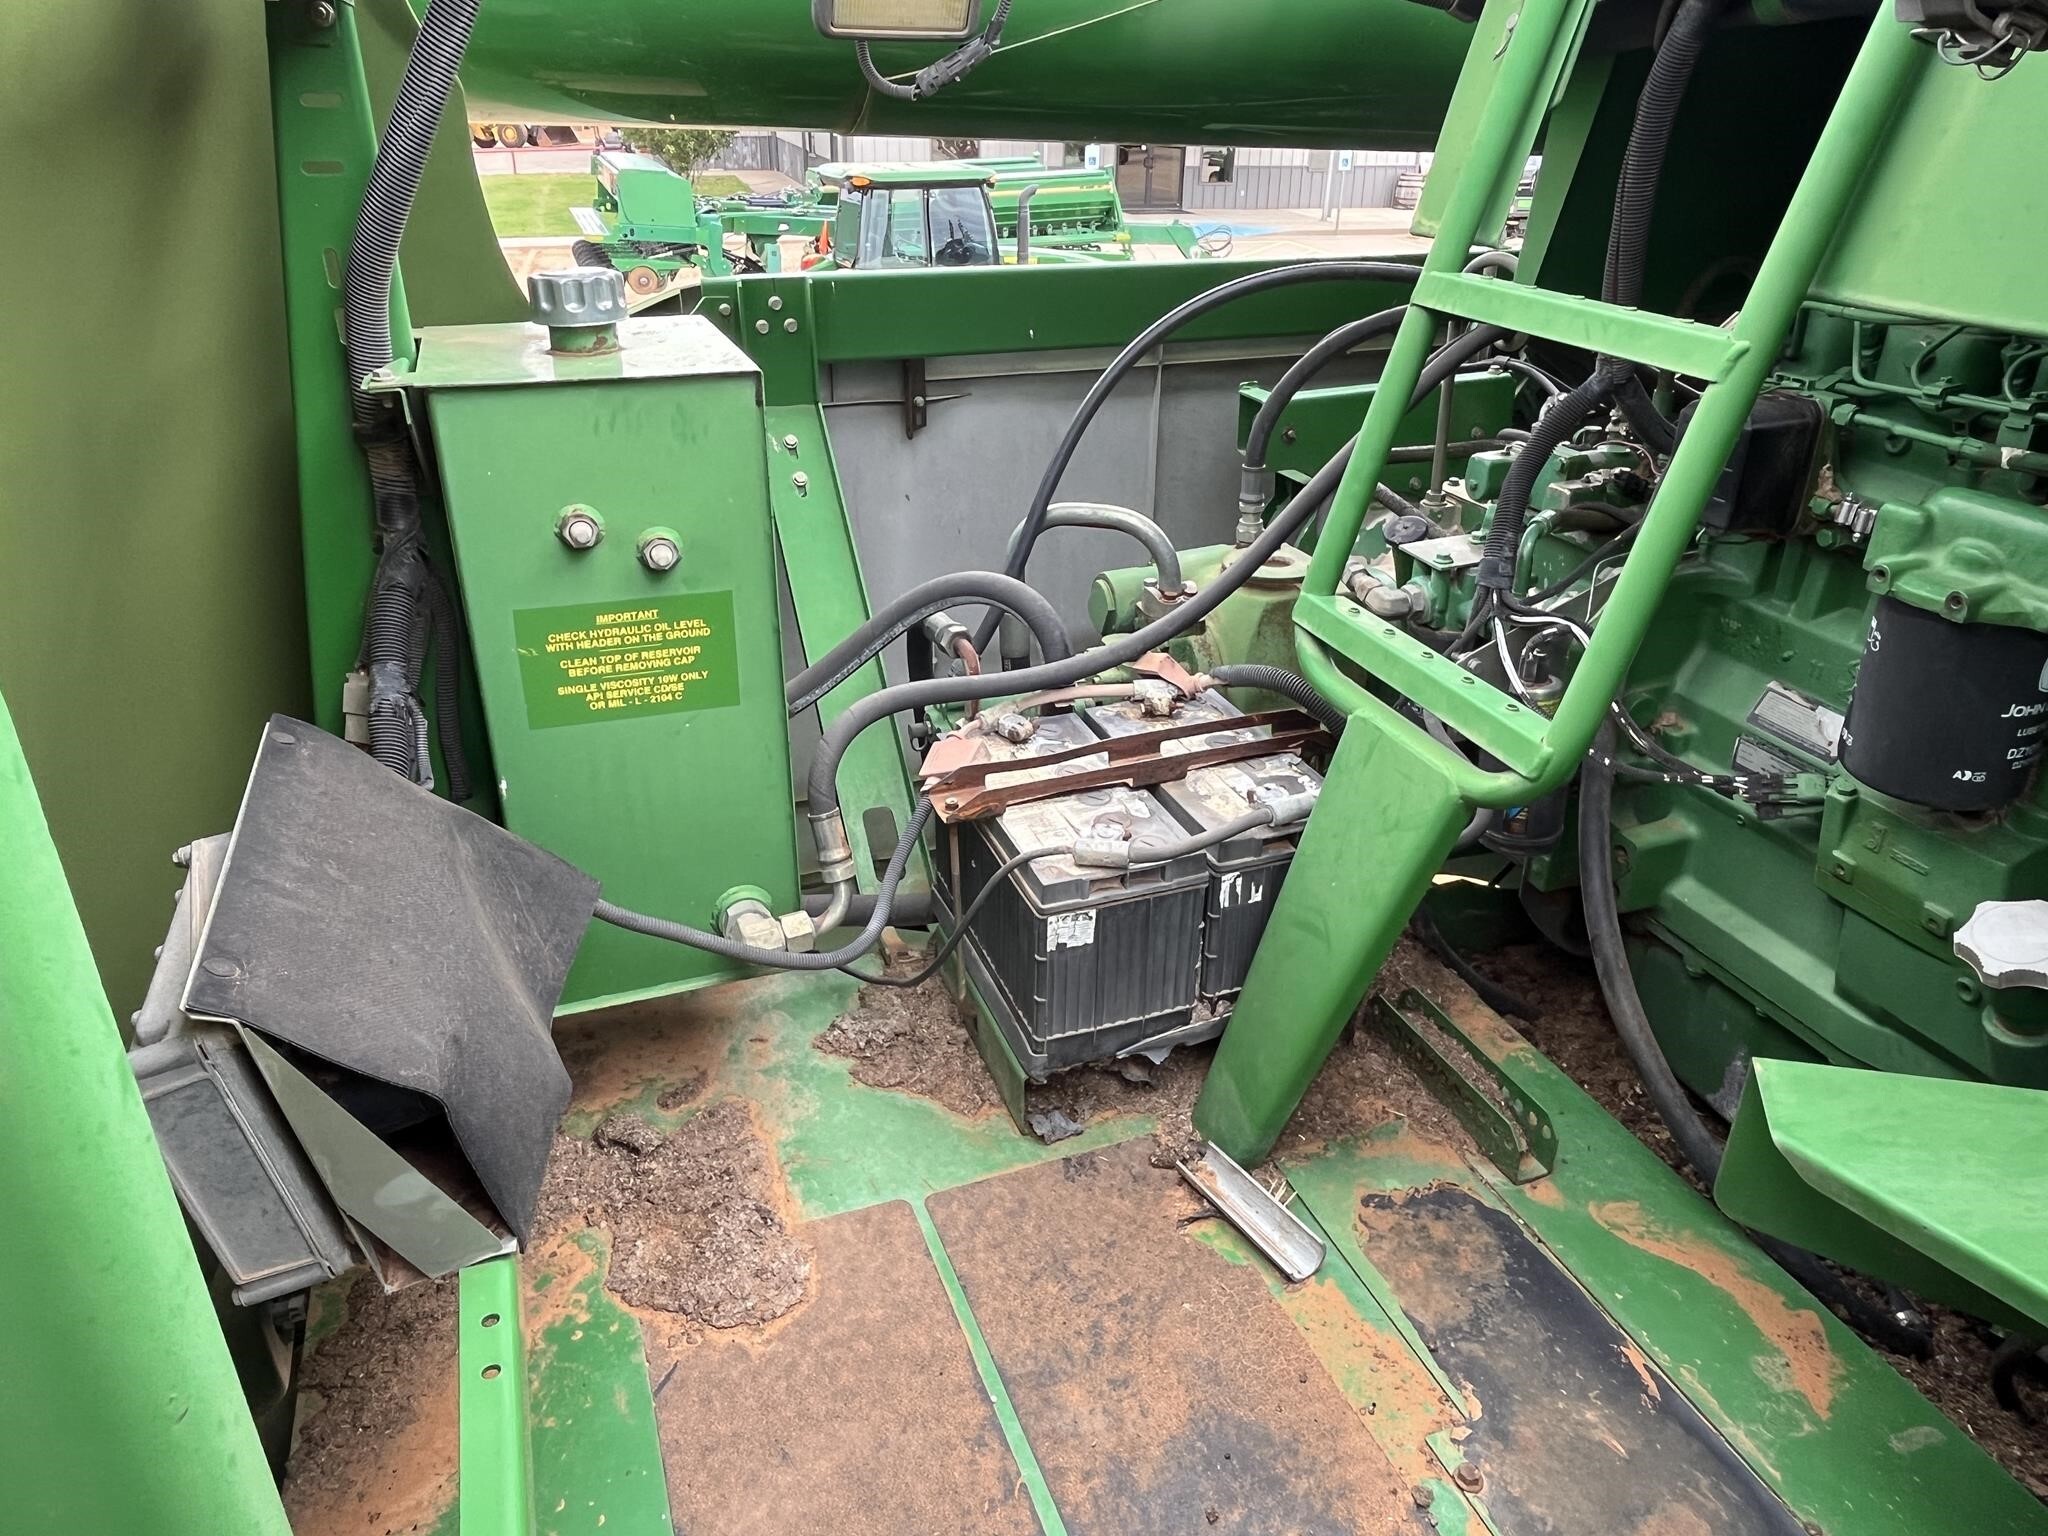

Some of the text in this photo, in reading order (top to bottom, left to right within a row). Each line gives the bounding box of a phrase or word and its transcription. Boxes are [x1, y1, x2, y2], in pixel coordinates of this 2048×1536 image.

[596, 609, 659, 624] IMPORTANT
[545, 627, 711, 653] WITH HEADER ON THE GROUND
[547, 618, 707, 643] CHECK HYDRAULIC OIL LEVEL
[559, 645, 701, 669] CLEAN TOP OF RESERVOIR
[568, 655, 696, 678] BEFORE REMOVING CAP
[557, 670, 709, 696] SINGLE VISCOSITY 10W ONLY
[585, 682, 685, 702] API SERVICE CD/SE
[589, 700, 606, 711] OR
[608, 698, 627, 709] MIL
[634, 697, 642, 705] L
[649, 692, 673, 704] 2104
[674, 691, 683, 700] C
[2000, 702, 2046, 718] JOHN
